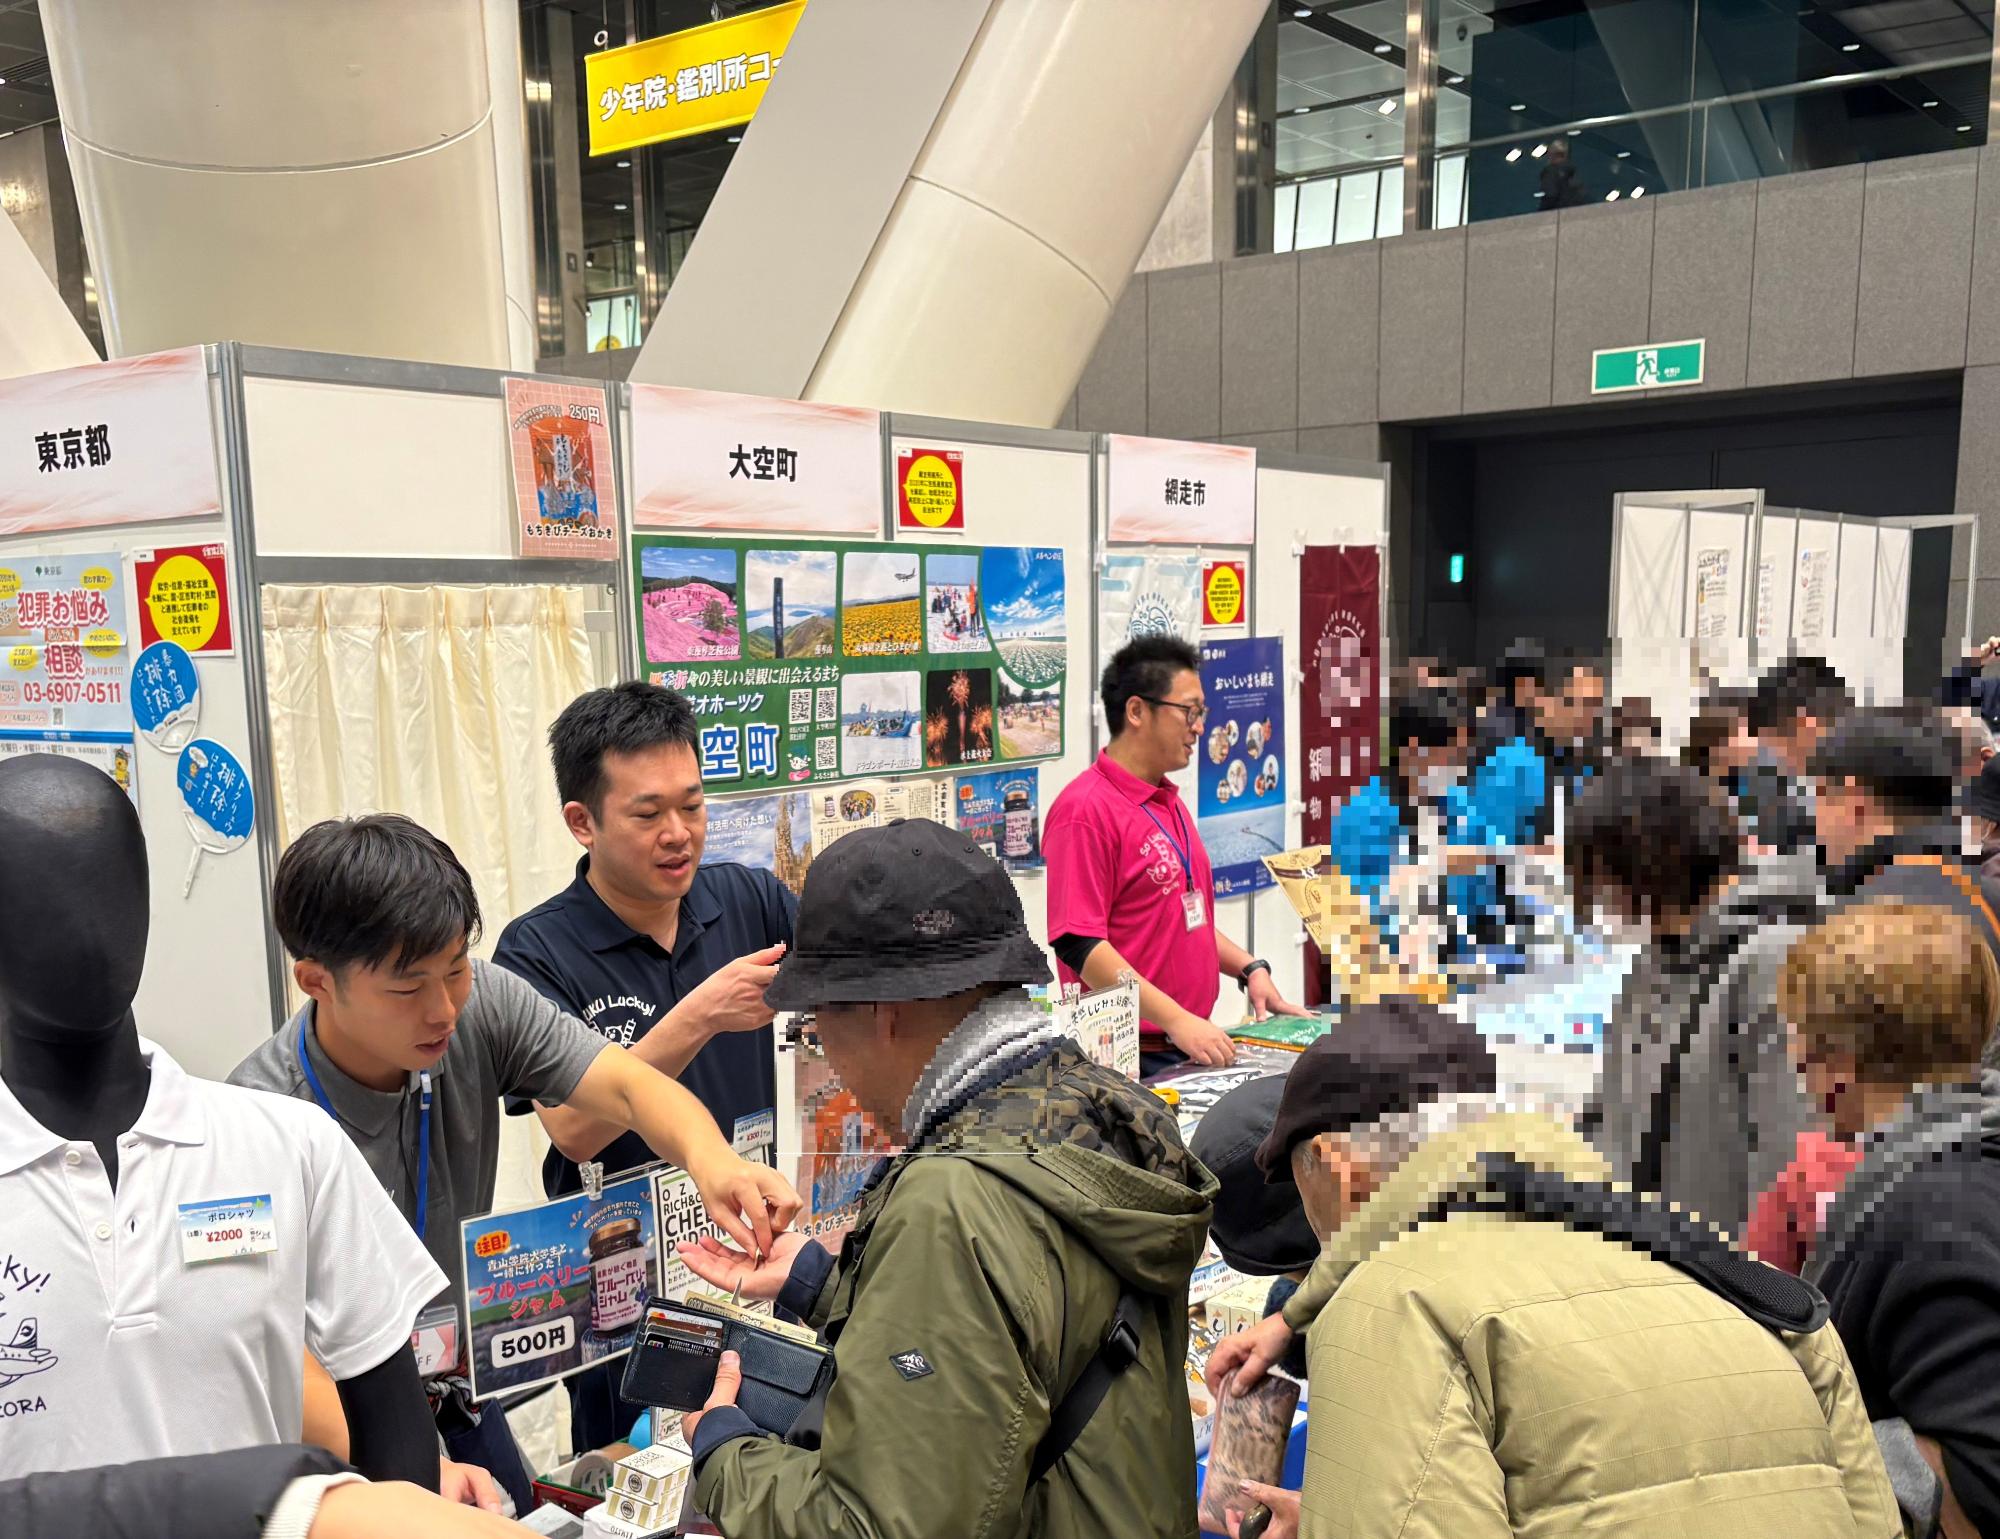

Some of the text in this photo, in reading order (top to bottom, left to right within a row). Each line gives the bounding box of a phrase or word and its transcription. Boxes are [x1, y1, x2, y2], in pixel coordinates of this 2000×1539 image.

[569, 403, 600, 425] 250円
[35, 424, 111, 473] 東京都
[729, 444, 798, 482] 大空町
[1165, 478, 1206, 507] 網走市
[526, 523, 612, 540] もちきびチーズおかき
[17, 590, 109, 627] 犯罪お悩み
[45, 644, 84, 680] 相談
[24, 682, 122, 703] 03-6907-0511
[144, 655, 172, 714] 排除
[700, 723, 780, 779] 空町
[607, 994, 657, 1017] Lucky!
[208, 1209, 254, 1223] ポロシャツ
[794, 1216, 855, 1237] ちきびチー
[206, 1228, 243, 1242] ¥2000
[477, 1233, 507, 1254] 注目!
[487, 1243, 567, 1272] 青山学院大学生と
[0, 1254, 51, 1293] ky!
[477, 1265, 591, 1306] ブルーベリー
[598, 1268, 646, 1294] ブルーベリー
[508, 1290, 565, 1320] ジャム
[600, 1290, 627, 1308] ジャム
[501, 1325, 566, 1359] 500円
[703, 1338, 720, 1348] VISA
[0, 1395, 47, 1419] ORA
